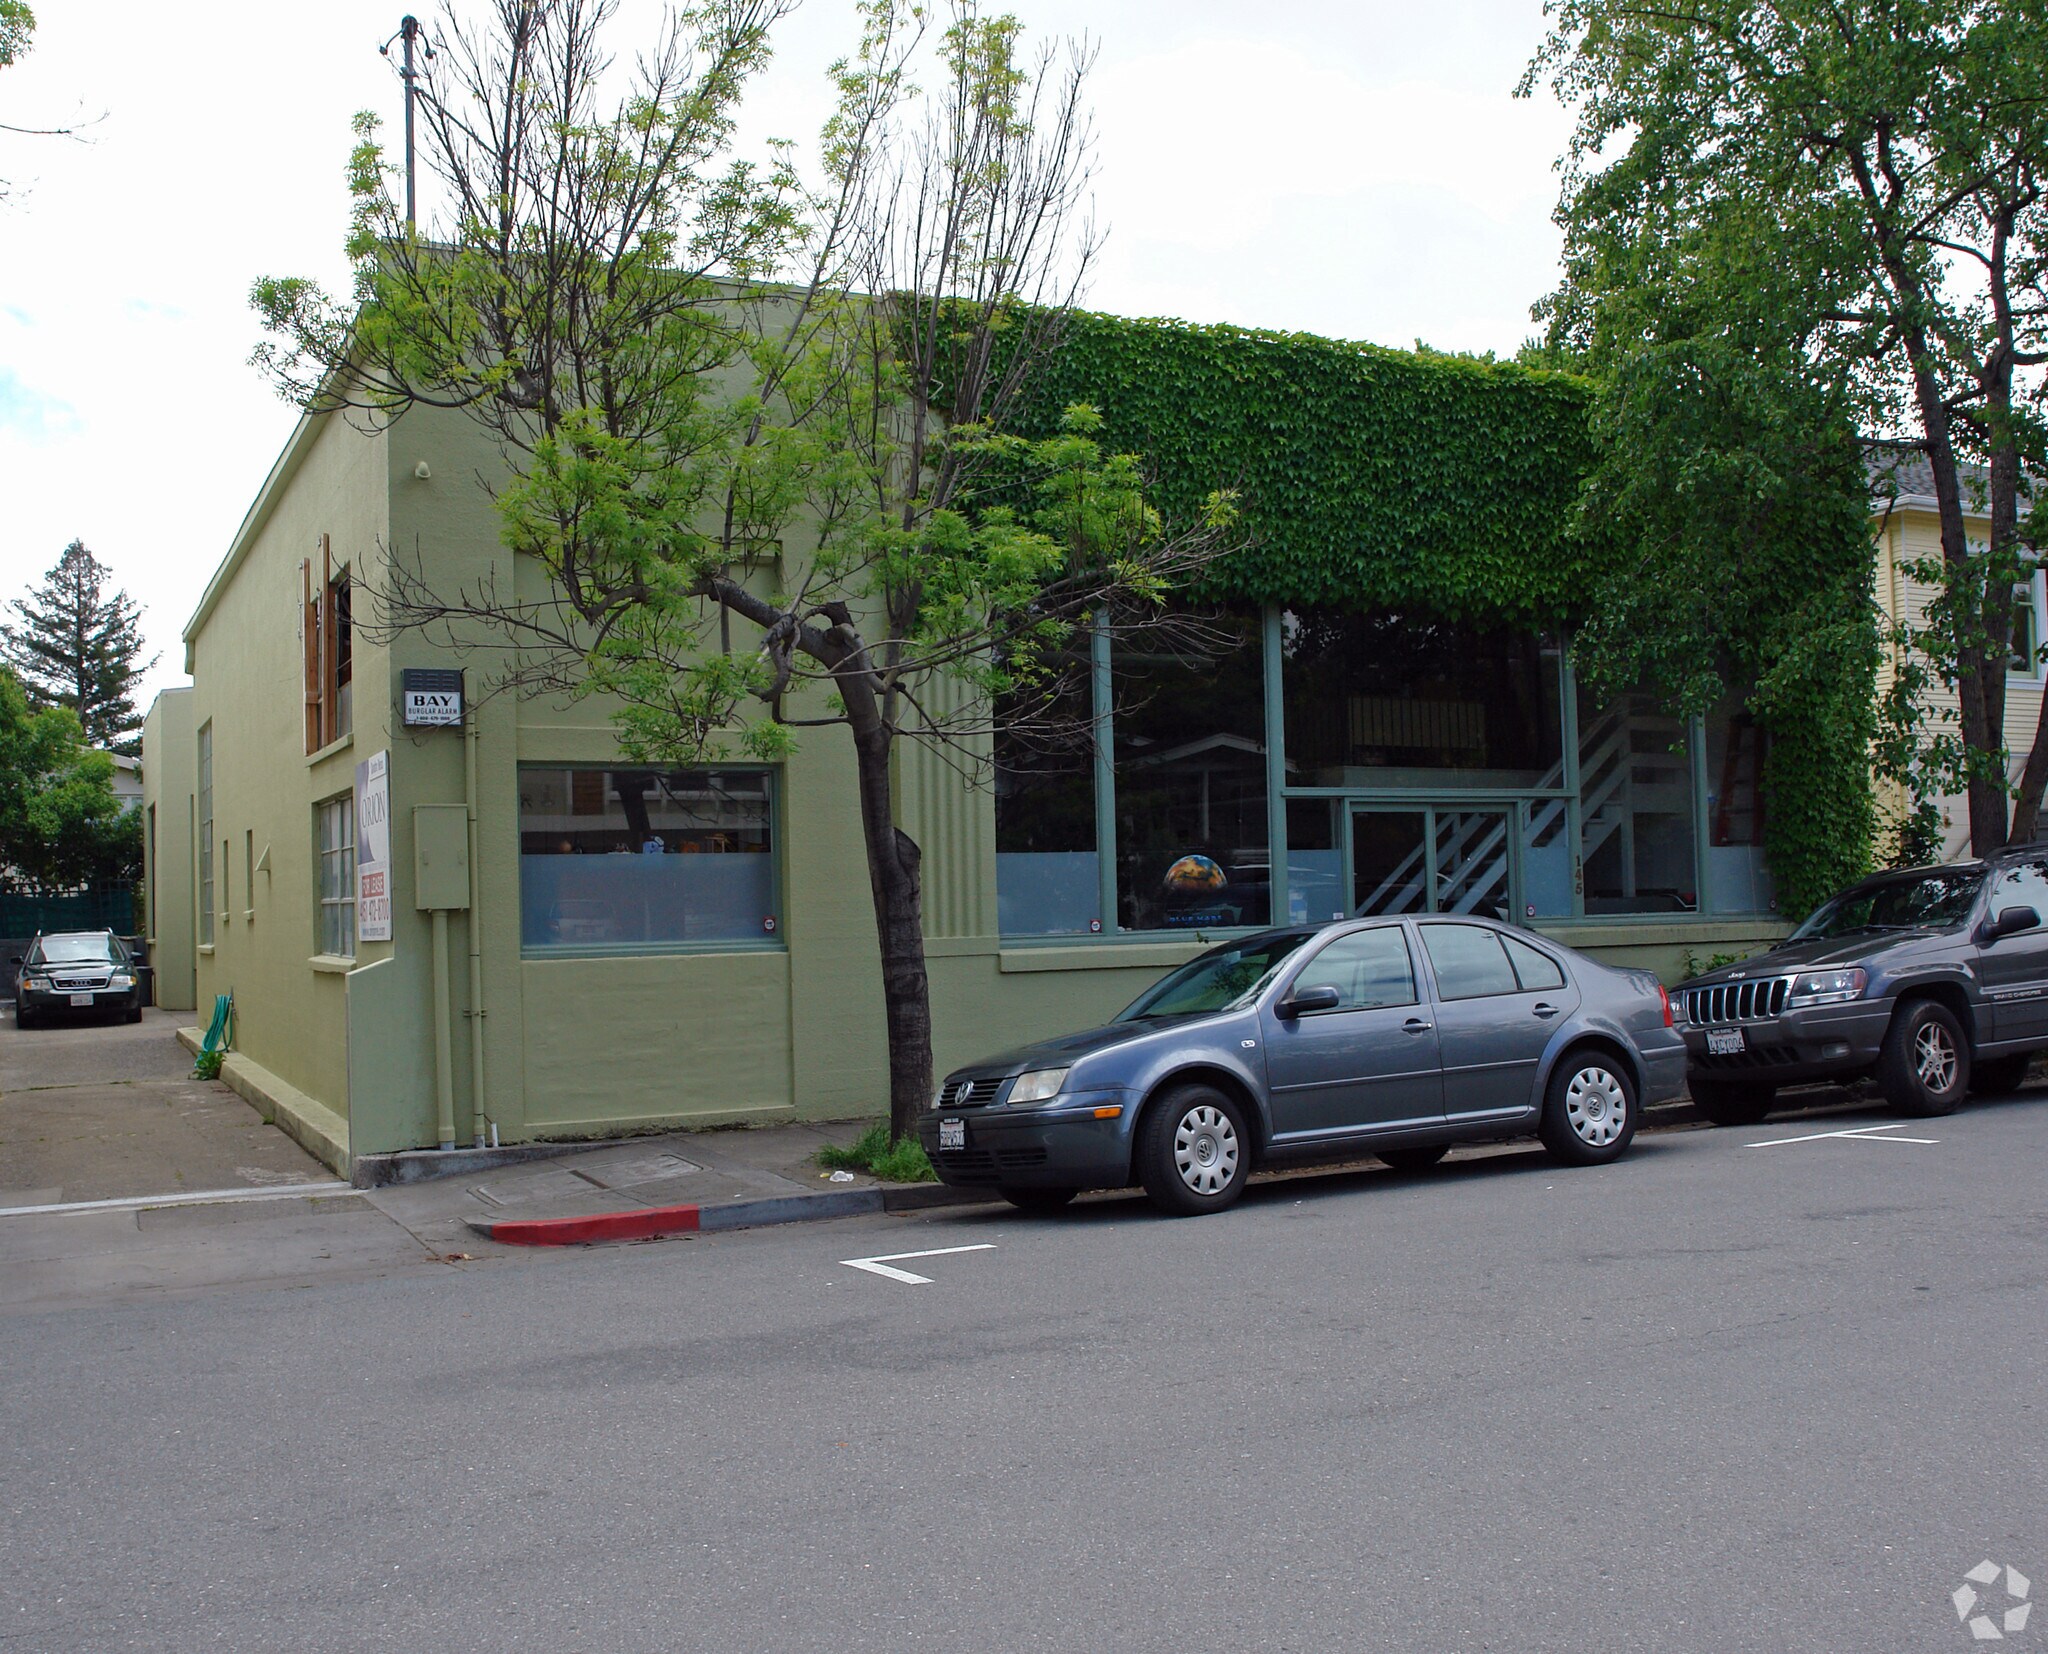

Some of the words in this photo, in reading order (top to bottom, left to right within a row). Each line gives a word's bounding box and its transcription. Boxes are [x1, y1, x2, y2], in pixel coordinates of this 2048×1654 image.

[413, 695, 453, 706] BAY
[361, 790, 386, 829] ORION
[363, 877, 371, 895] FOR
[371, 874, 384, 893] LEASE
[1575, 854, 1583, 895] 145
